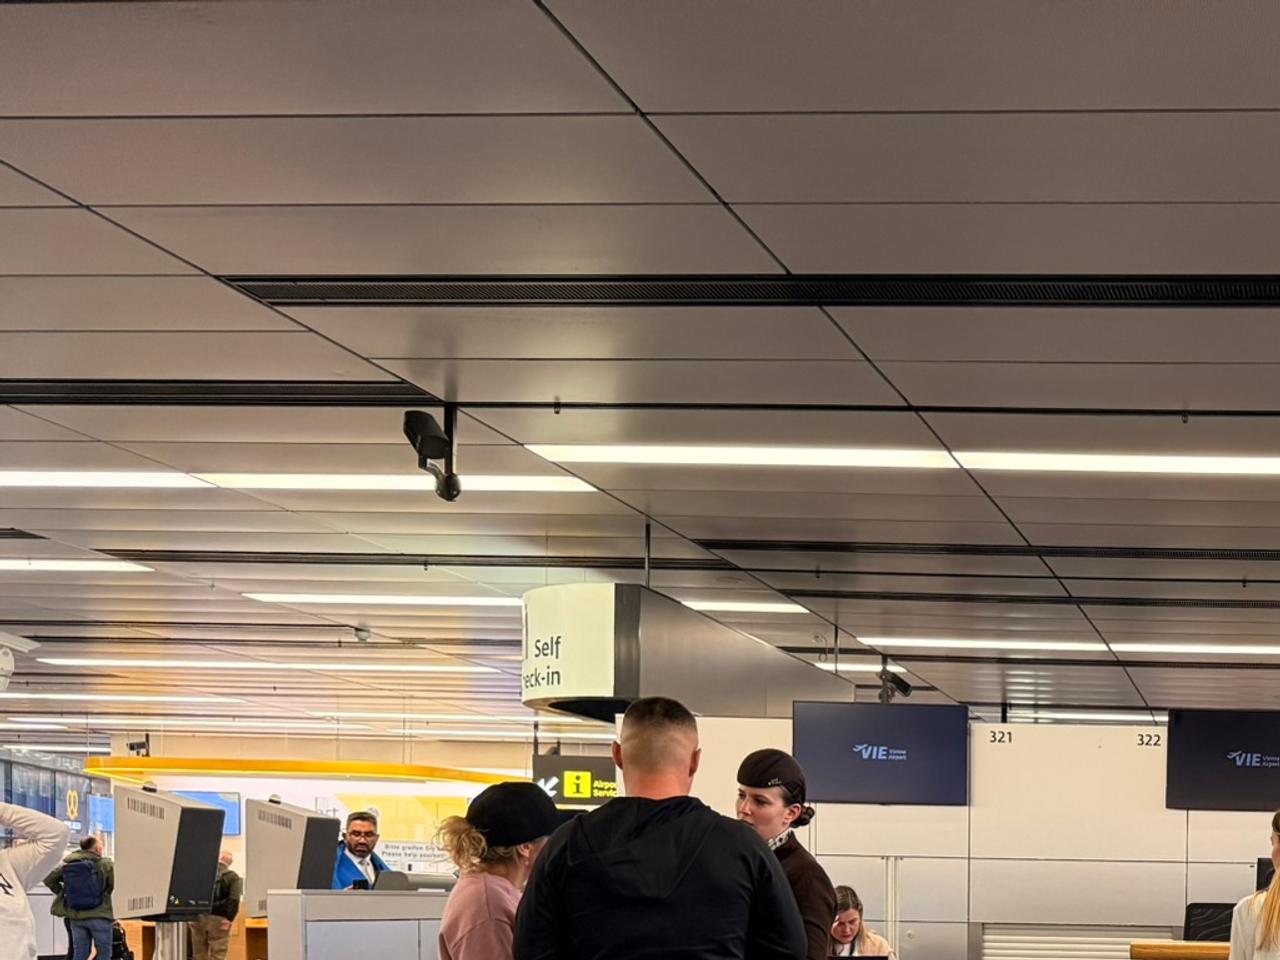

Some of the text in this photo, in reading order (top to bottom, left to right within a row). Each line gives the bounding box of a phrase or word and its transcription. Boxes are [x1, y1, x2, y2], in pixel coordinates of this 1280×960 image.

[534, 636, 562, 659] Self
[523, 665, 560, 688] eck-in
[989, 731, 1013, 743] 321
[1137, 734, 1161, 746] 322
[862, 746, 888, 760] VIE
[1234, 753, 1261, 766] VIE
[593, 780, 616, 790] Airpo
